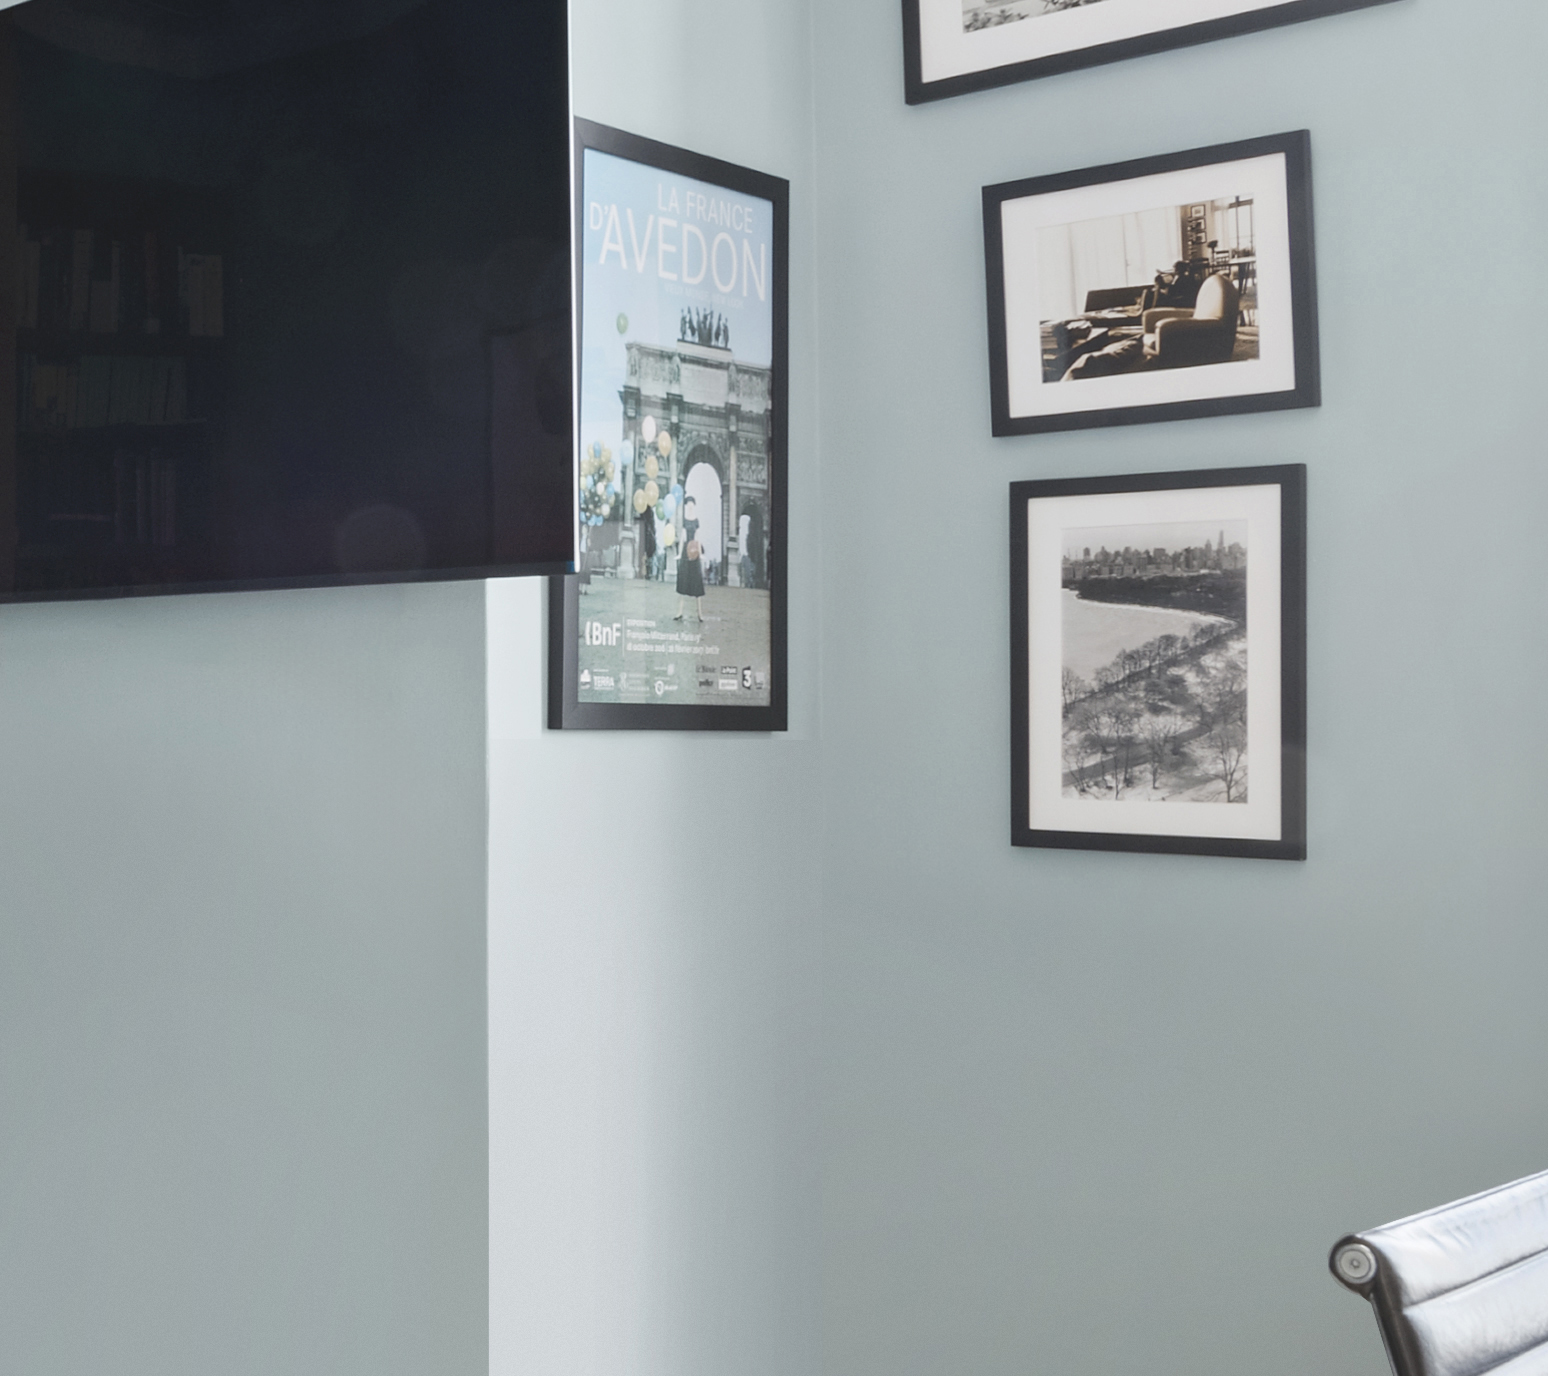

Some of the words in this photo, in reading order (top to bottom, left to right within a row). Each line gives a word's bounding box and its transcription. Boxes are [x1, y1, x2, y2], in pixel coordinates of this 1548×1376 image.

[658, 183, 680, 214] LA
[686, 190, 753, 234] FRANCE
[589, 201, 765, 302] D'AVEDON
